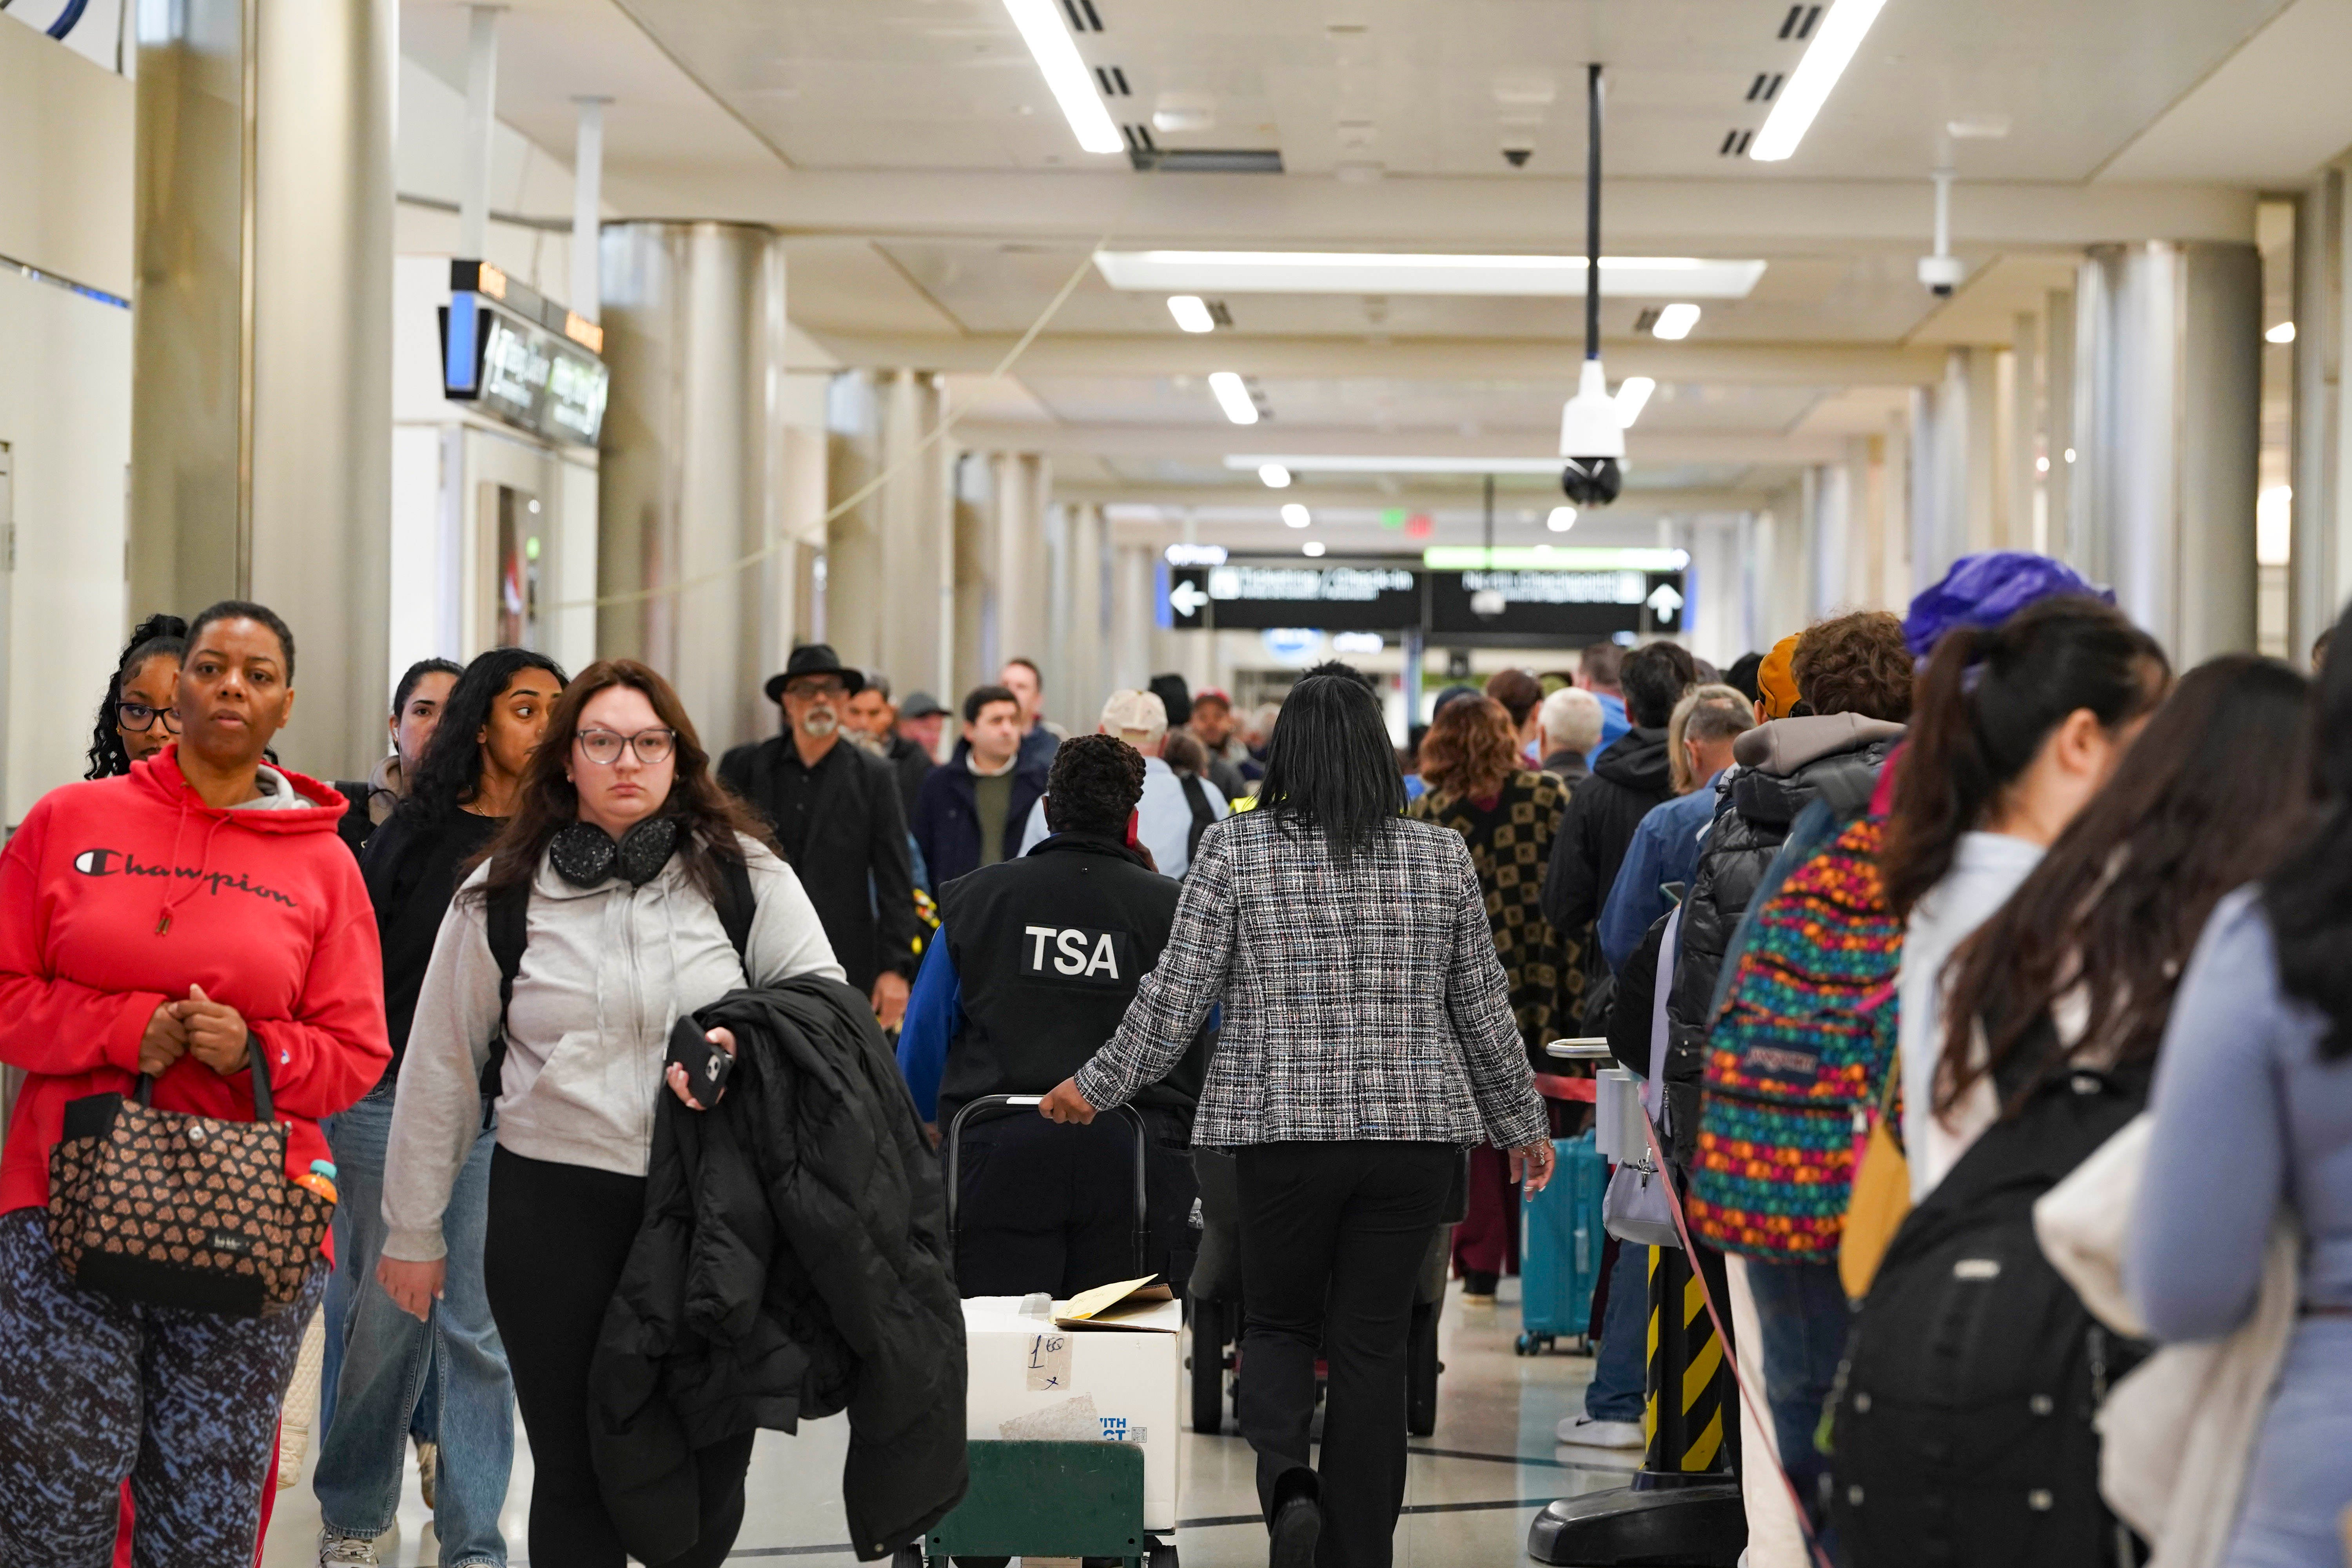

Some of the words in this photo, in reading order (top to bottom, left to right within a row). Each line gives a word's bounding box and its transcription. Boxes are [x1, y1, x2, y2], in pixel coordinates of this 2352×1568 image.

[75, 848, 298, 907] Champion
[1025, 926, 1119, 979] TSA
[1100, 1418, 1126, 1428] ITH
